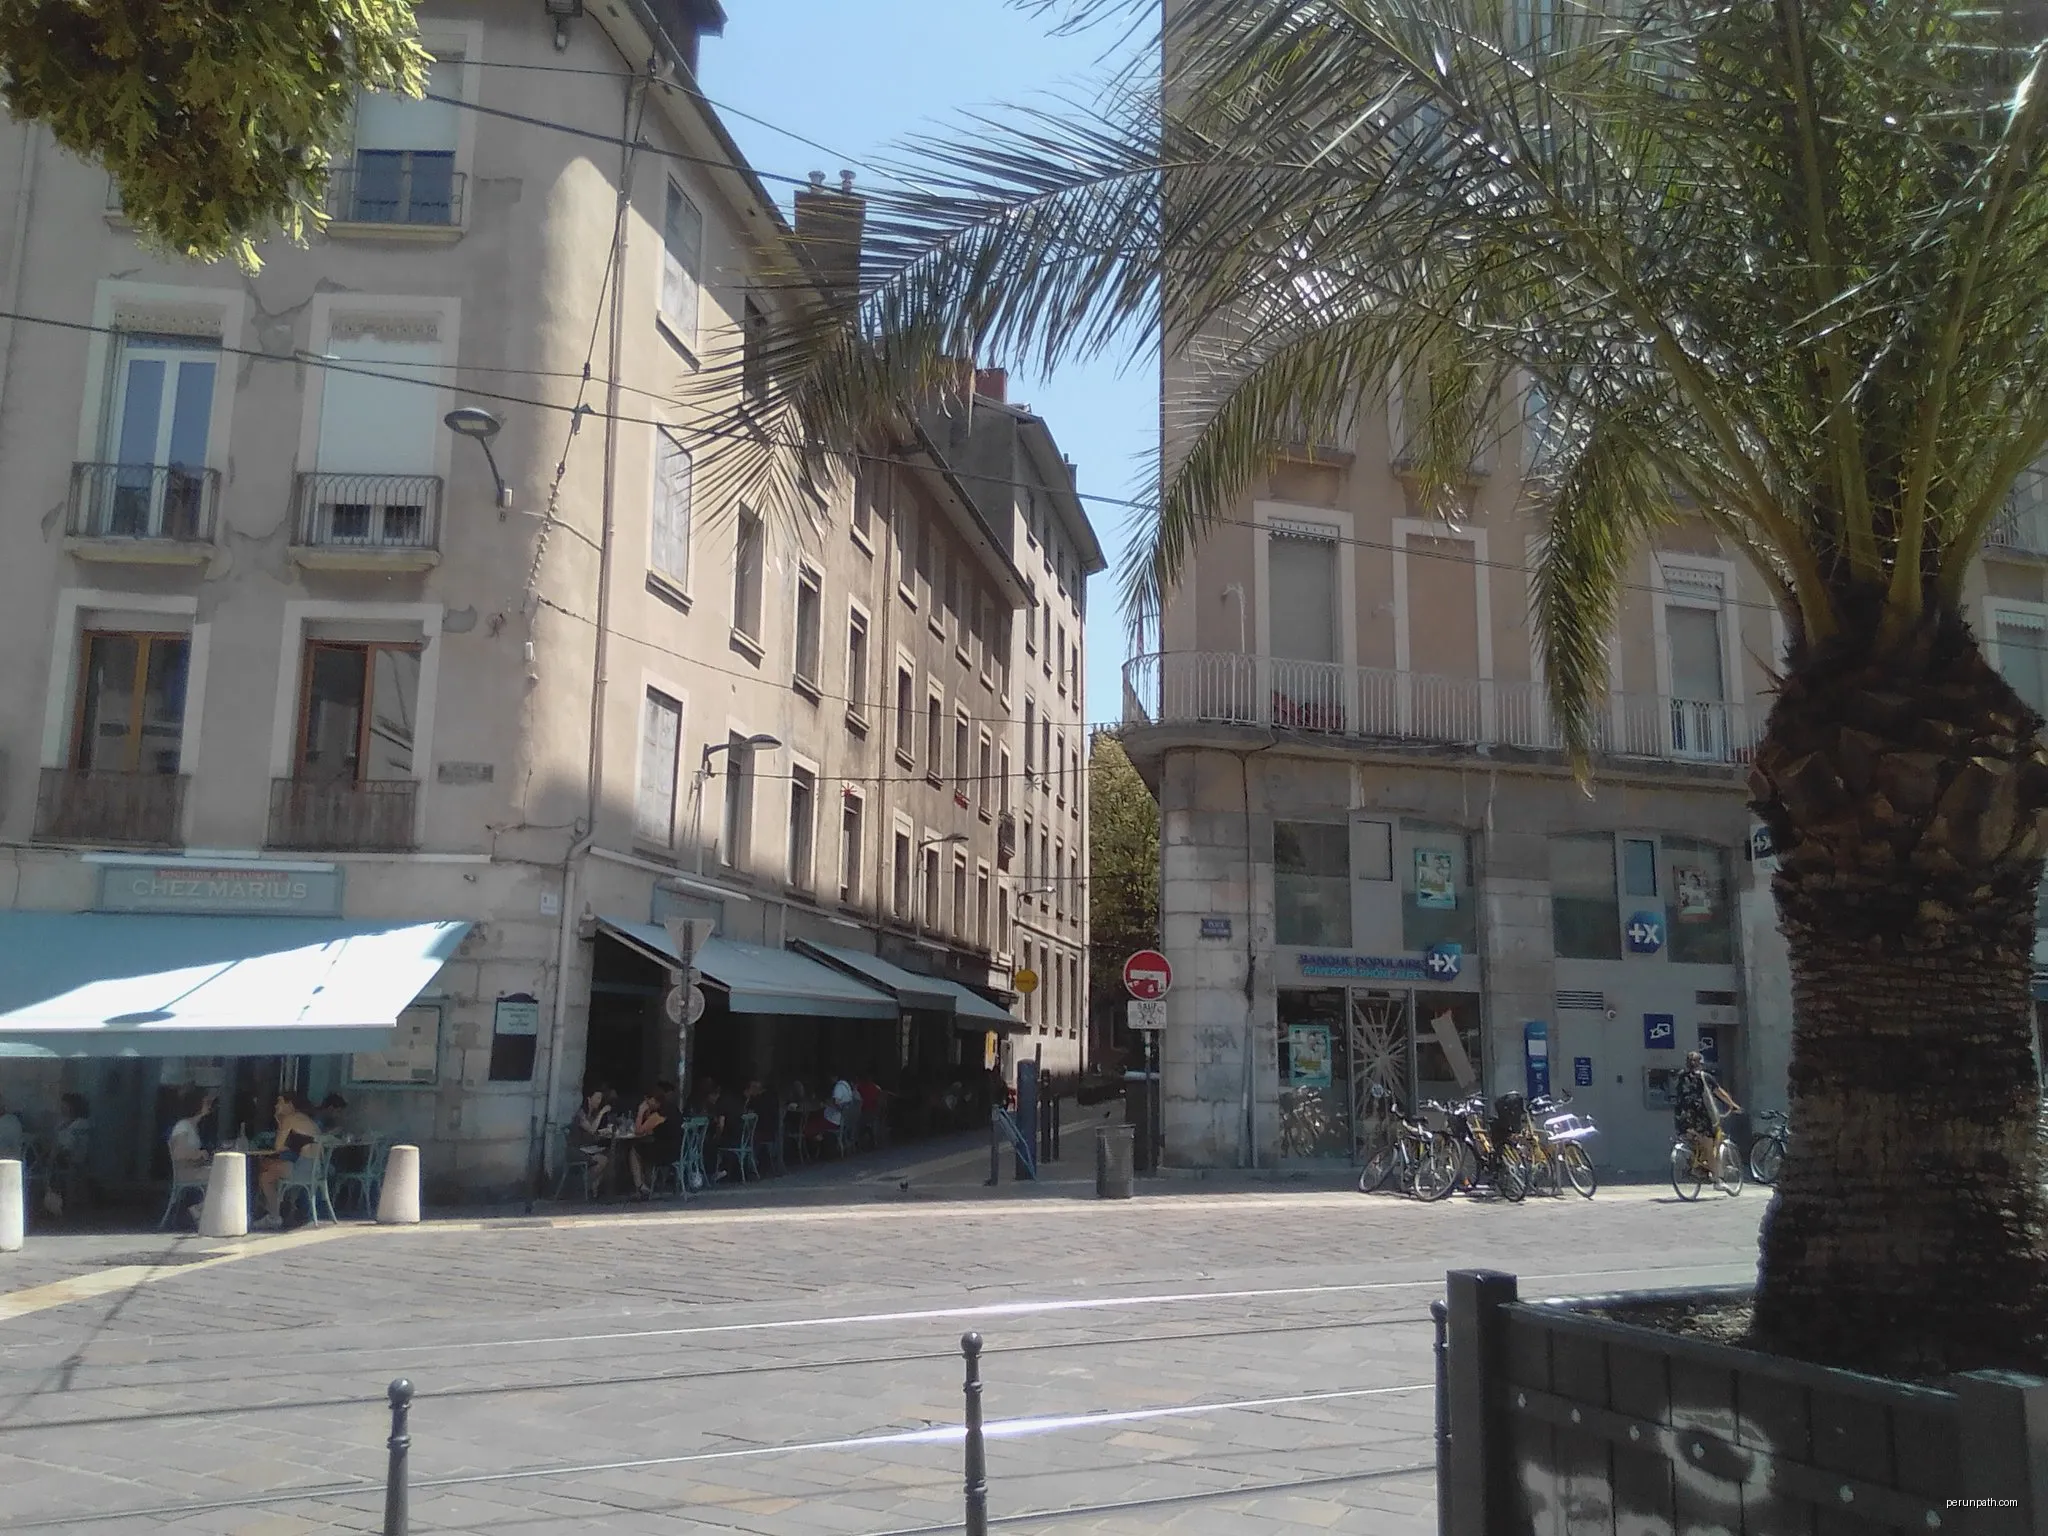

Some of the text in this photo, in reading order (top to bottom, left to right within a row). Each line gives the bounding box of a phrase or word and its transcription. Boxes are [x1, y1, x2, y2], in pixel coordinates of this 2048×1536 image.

[132, 879, 308, 899] CHEZ MARIUS
[1299, 953, 1427, 968] BANQUE POPULAIRE
